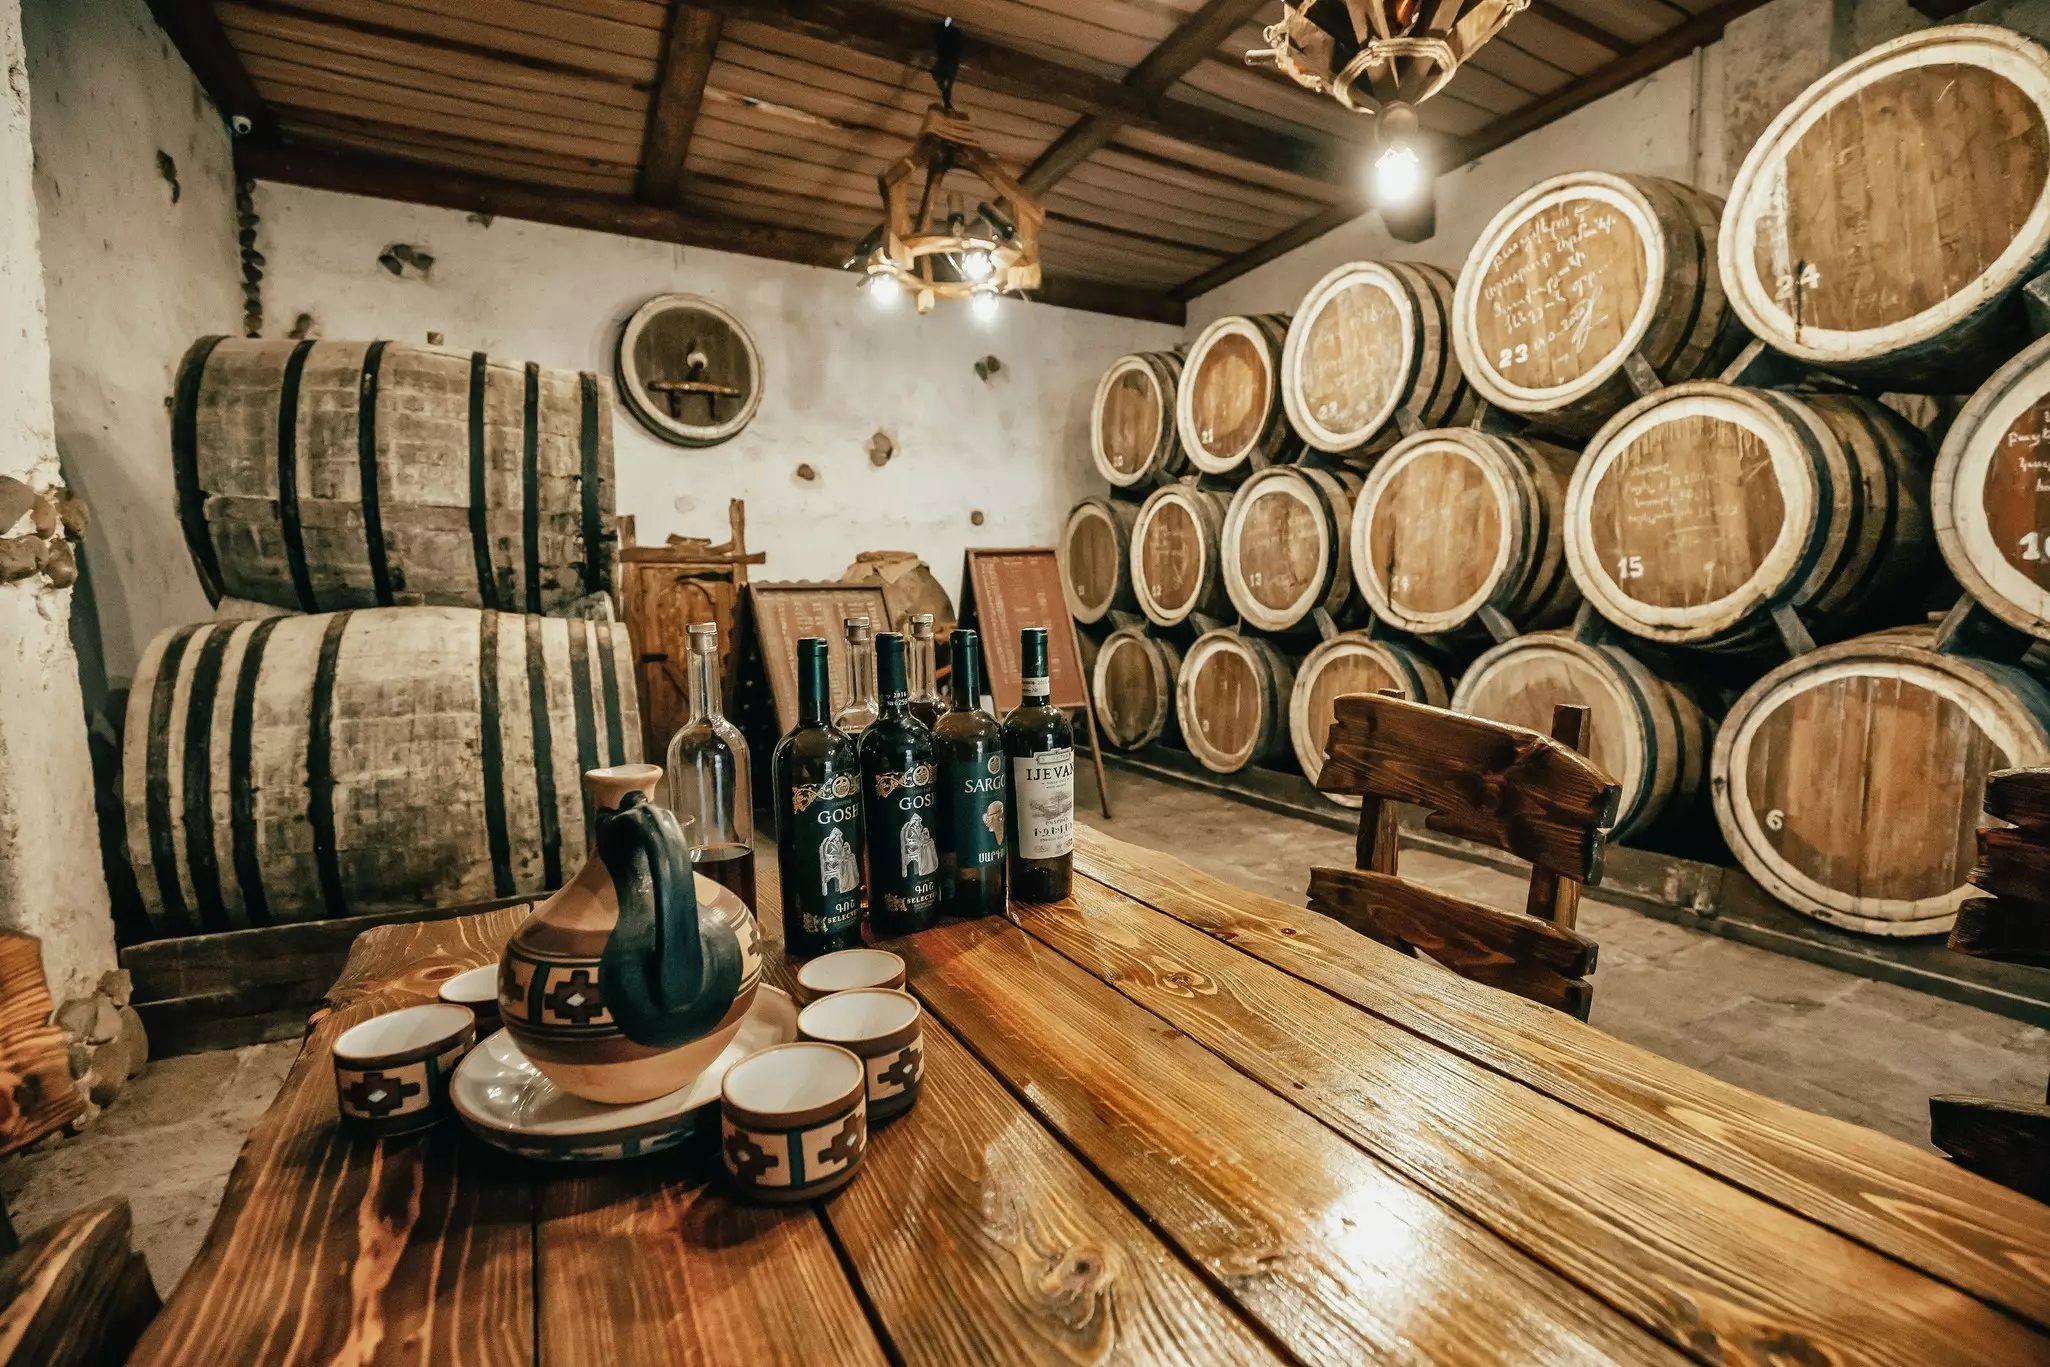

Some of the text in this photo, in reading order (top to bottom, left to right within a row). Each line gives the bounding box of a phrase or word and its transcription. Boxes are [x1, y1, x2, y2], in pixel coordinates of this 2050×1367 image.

[1775, 263, 1820, 300] 24
[1499, 343, 1529, 369] 23
[1617, 556, 1644, 579] 15
[1249, 572, 1262, 587] 13
[898, 792, 937, 811] GOSH
[817, 803, 860, 825] GOSH
[1765, 808, 1784, 831] 6
